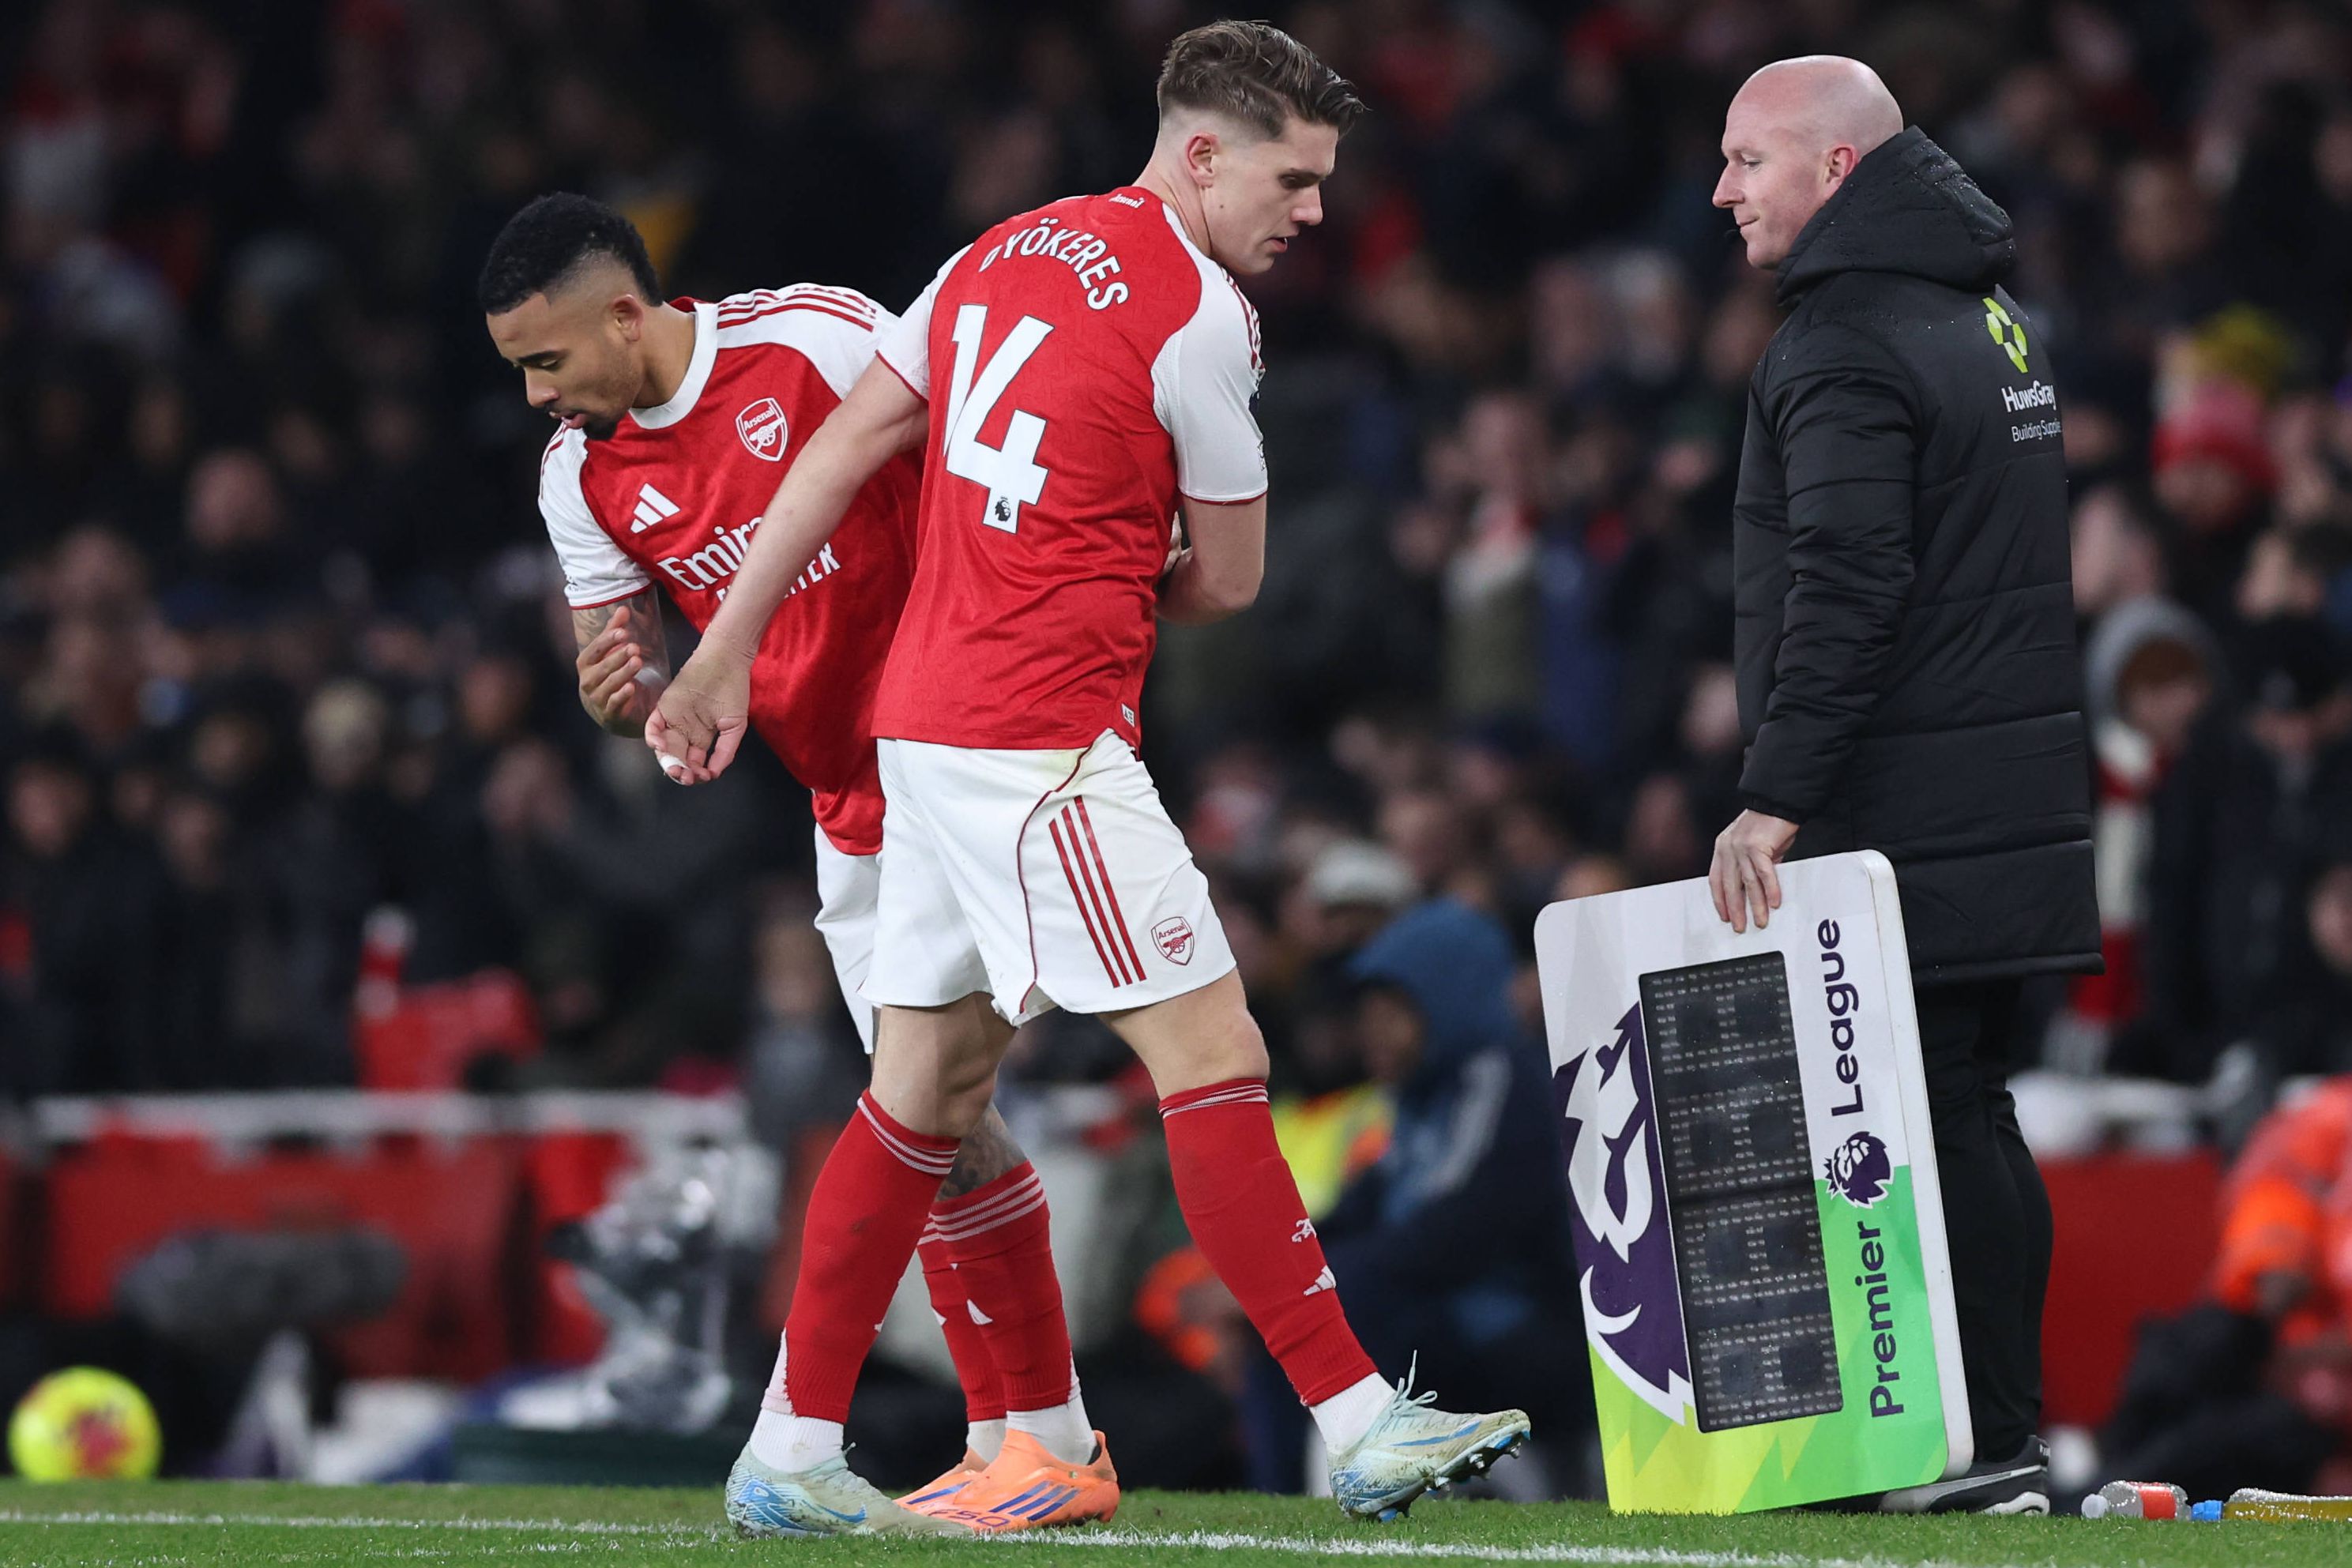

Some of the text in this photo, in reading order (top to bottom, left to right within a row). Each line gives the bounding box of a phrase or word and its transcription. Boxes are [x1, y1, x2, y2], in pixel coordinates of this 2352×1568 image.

[743, 406, 776, 431] Arsenal
[943, 303, 1056, 535] 14
[2011, 423, 2042, 442] Building
[1158, 923, 1185, 939] Arsenal
[1817, 919, 1904, 1417] Premier League
